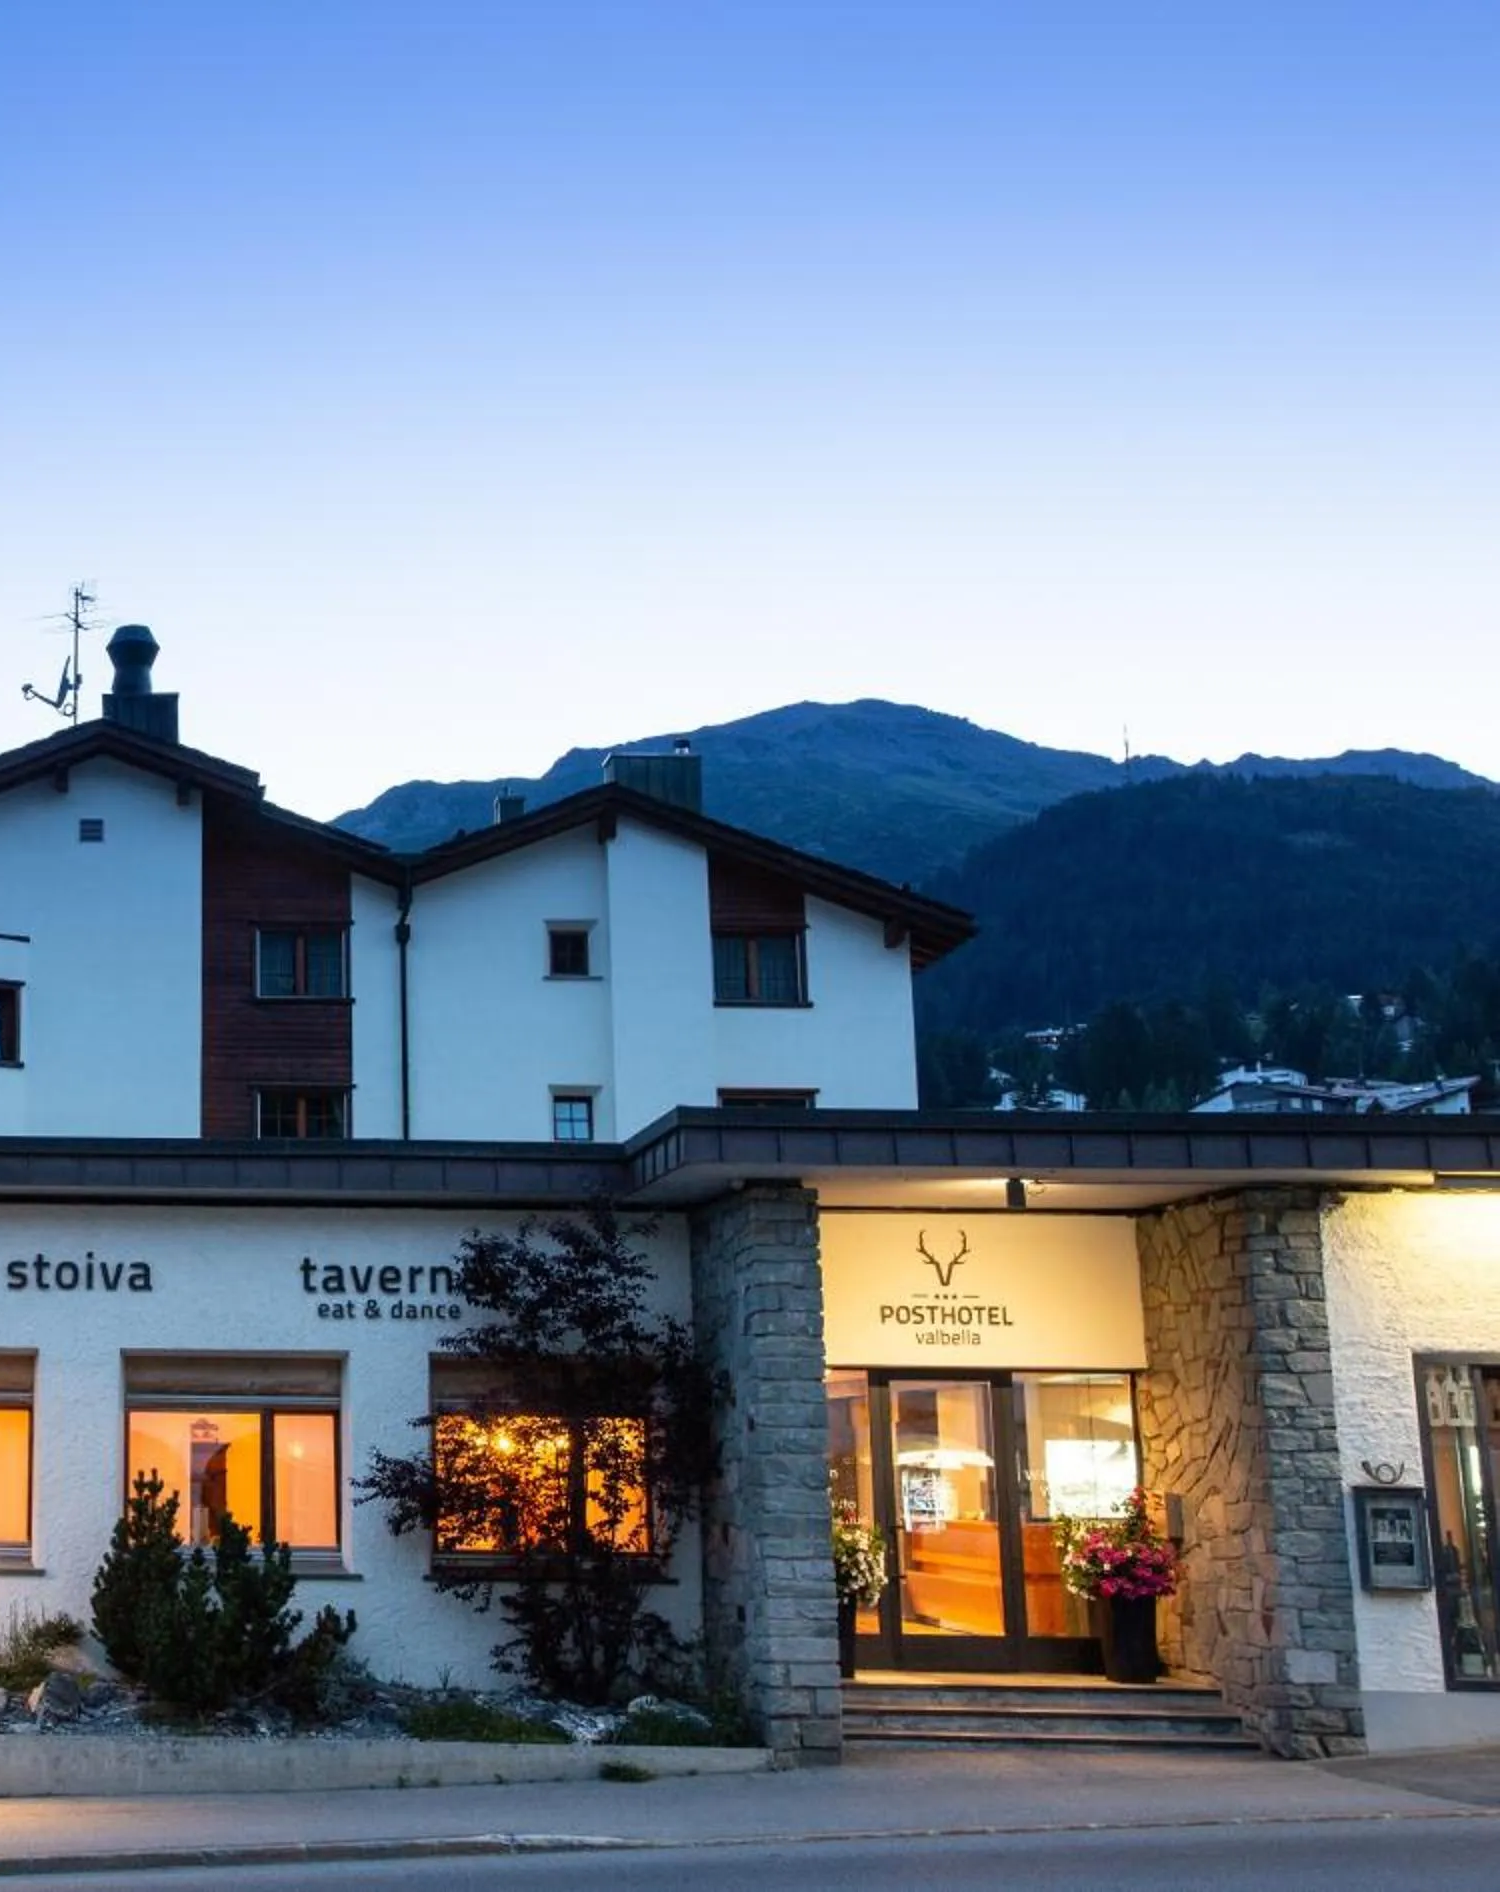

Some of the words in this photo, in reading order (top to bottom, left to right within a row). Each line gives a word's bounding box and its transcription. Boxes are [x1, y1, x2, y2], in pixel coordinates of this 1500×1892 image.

[6, 1251, 153, 1292] stoiva
[300, 1257, 468, 1294] tavern
[317, 1301, 356, 1319] eat
[364, 1300, 381, 1319] &
[391, 1301, 461, 1319] dance
[880, 1305, 1013, 1326] POSTHOTEL
[915, 1329, 981, 1345] valbella
